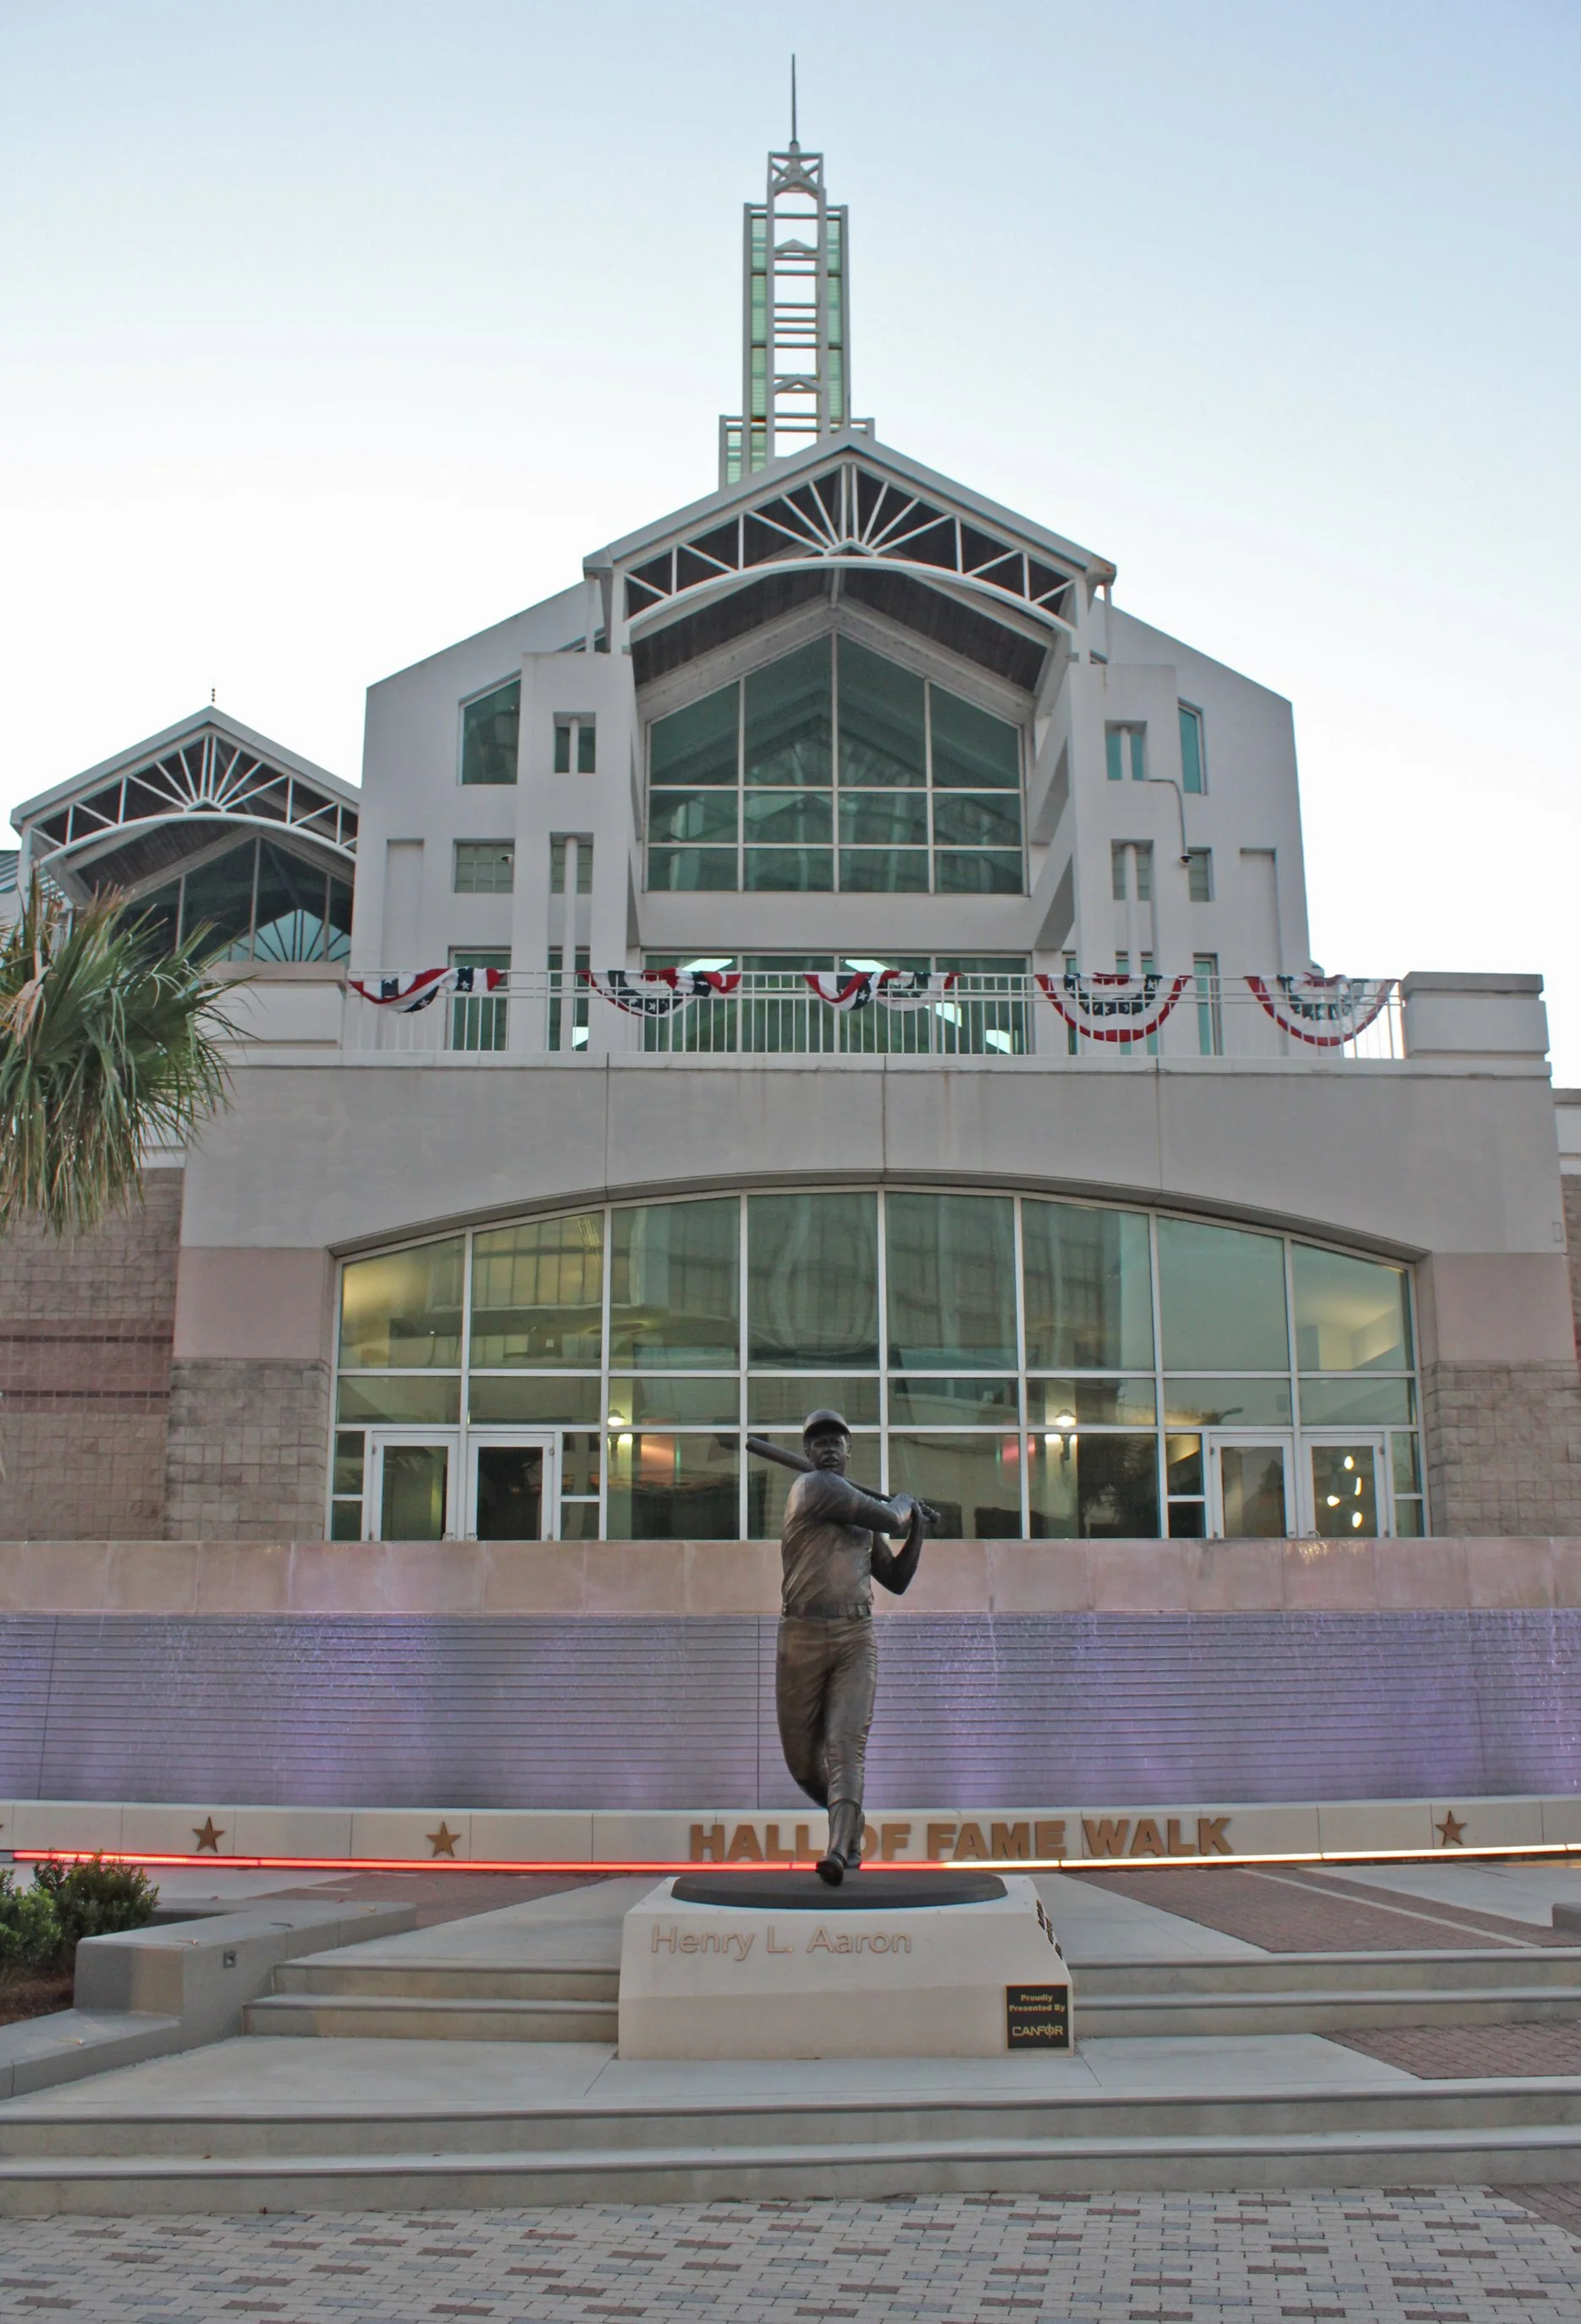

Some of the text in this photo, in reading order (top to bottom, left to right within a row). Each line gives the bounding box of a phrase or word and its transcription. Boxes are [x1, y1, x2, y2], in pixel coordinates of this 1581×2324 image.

[690, 1824, 824, 1863] HALL
[927, 1820, 1067, 1861] FAME
[1082, 1817, 1232, 1858] WALK
[651, 1925, 912, 1962] Henry L. Aaron
[1020, 1994, 1054, 2002] Proudly
[1054, 2003, 1066, 2013] By
[1011, 2023, 1064, 2039] CANFOR
